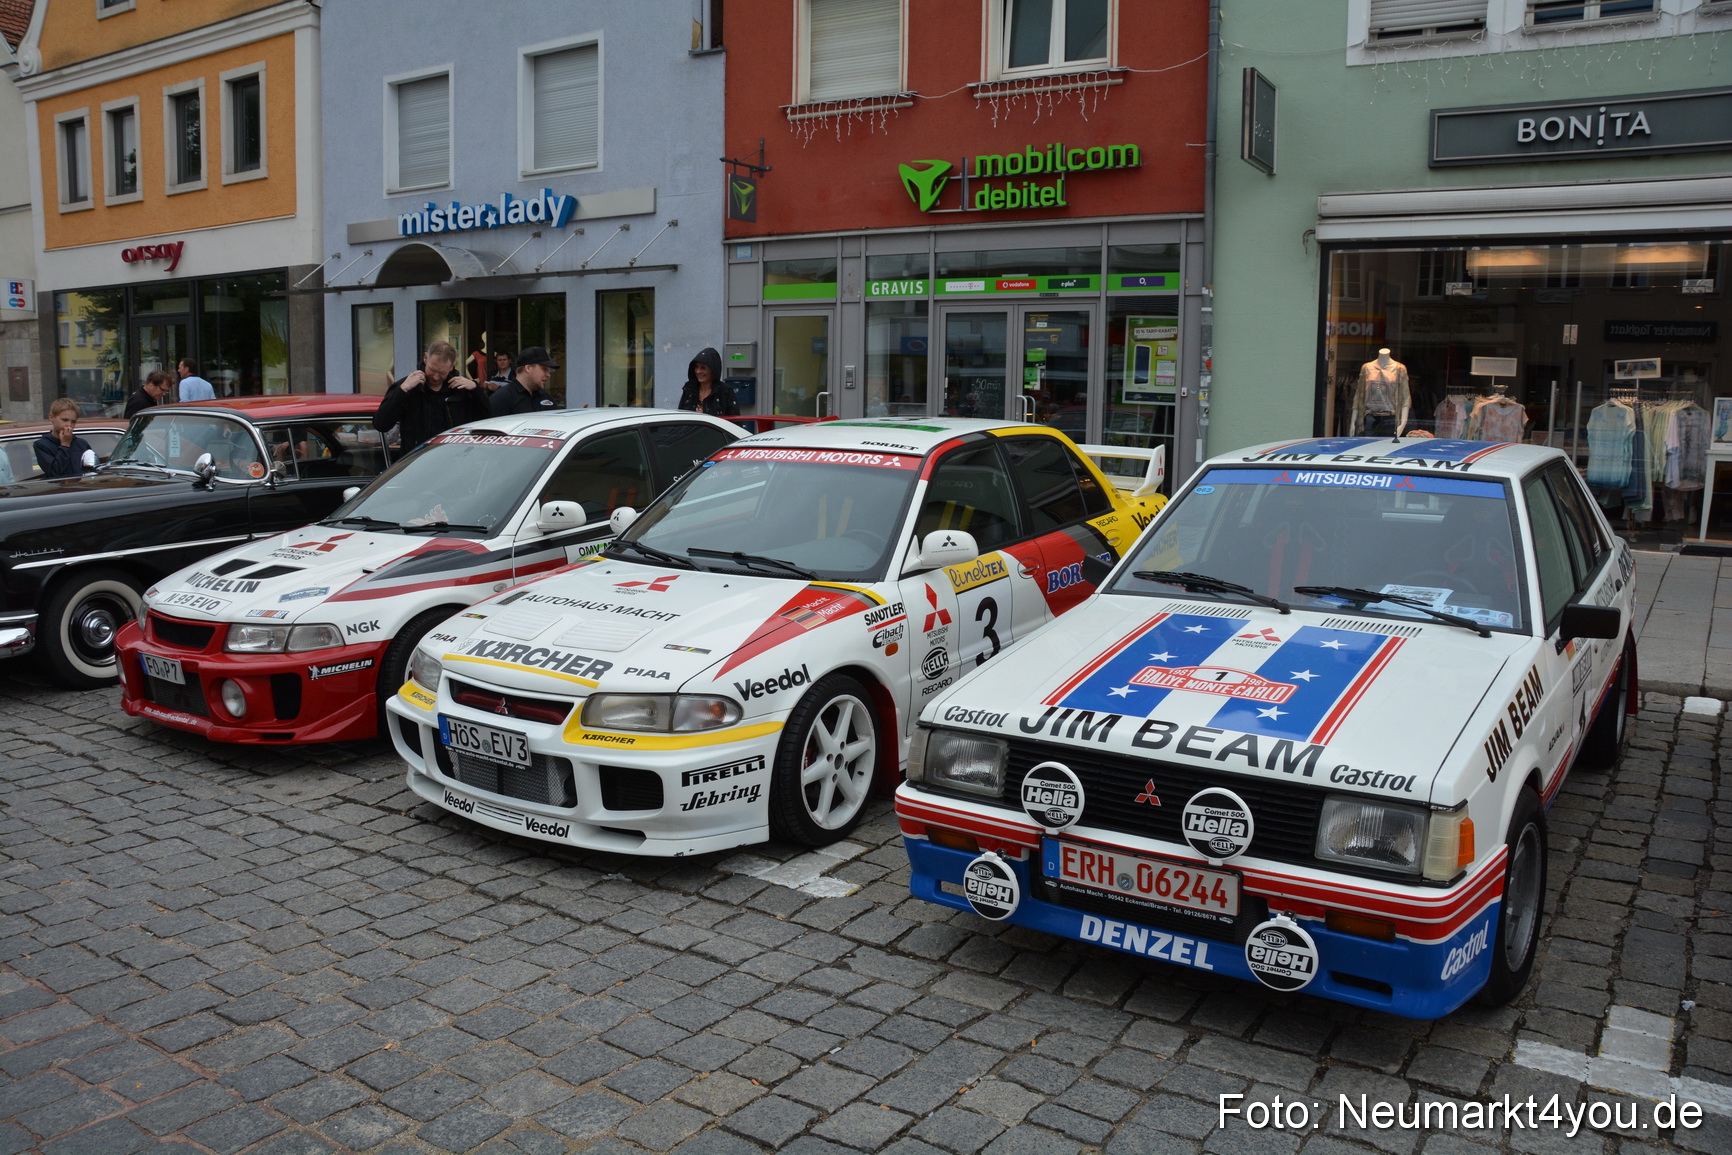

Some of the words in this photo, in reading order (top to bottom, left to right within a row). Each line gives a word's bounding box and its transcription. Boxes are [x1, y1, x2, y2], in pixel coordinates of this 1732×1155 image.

[976, 143, 1141, 177] mobilcom
[975, 178, 1068, 210] debitel
[397, 202, 493, 235] mister
[500, 187, 579, 228] lady
[121, 240, 185, 272] orsay
[871, 280, 924, 296] GRAVIS
[440, 435, 528, 446] MITSUBISHI
[860, 440, 919, 451] BORBET
[734, 449, 815, 461] MITSUBISHI
[814, 452, 884, 465] MOTORS
[1242, 453, 1320, 463] JIM
[1330, 454, 1473, 472] BEAM
[1295, 472, 1393, 488] MITSUBISHI
[185, 571, 262, 593] MICHELIN
[189, 597, 222, 611] EVO
[521, 593, 614, 612] AUTOHAUS
[610, 605, 682, 622] MACHT
[817, 602, 846, 618] Macht
[345, 619, 381, 636] NGK
[429, 632, 458, 643] PIAA
[872, 623, 904, 649] Eibach
[975, 596, 1001, 667] 3
[1231, 638, 1279, 648] MITSUBISHI
[320, 659, 373, 675] MICHELIN
[465, 639, 614, 681] KÄRCHER
[923, 650, 950, 674] HELLA
[623, 667, 671, 680] PIAA
[733, 664, 813, 702] Veedol
[1168, 668, 1194, 677] 1981
[1214, 671, 1230, 682] 1
[1243, 677, 1268, 687] 1981
[921, 676, 953, 697] RECARO
[1137, 670, 1185, 687] RALLYE
[1182, 679, 1286, 701] MONTE-CARLO
[943, 705, 1011, 729] Castrol
[1484, 718, 1513, 783] JIM
[1507, 663, 1545, 741] BEAM
[490, 731, 513, 758] EV
[516, 737, 528, 762] 3
[1019, 706, 1123, 743] JIM
[1131, 719, 1326, 778] BEAM
[681, 754, 766, 788] PIRELLI
[1329, 764, 1418, 793] Castrol
[1040, 780, 1062, 788] Comet
[443, 790, 476, 814] Veedol
[680, 784, 762, 812] Sebring
[1026, 786, 1077, 808] Hella
[1046, 811, 1068, 820] HELLA
[1204, 807, 1230, 817] Comet
[525, 816, 571, 839] Veedol
[1188, 813, 1246, 837] Hella
[1211, 841, 1235, 850] HELLA
[1062, 846, 1115, 886] ERH
[1136, 862, 1228, 909] 06244
[967, 878, 1011, 902] Hella
[1059, 883, 1086, 894] Autohaus
[1086, 888, 1104, 898] Macht
[1172, 906, 1183, 915] Tel.
[1079, 914, 1214, 971] DENZEL
[1440, 919, 1489, 981] Castrol
[1250, 962, 1266, 971] 500
[1251, 945, 1310, 972] Hella
[1266, 966, 1292, 976] Comet
